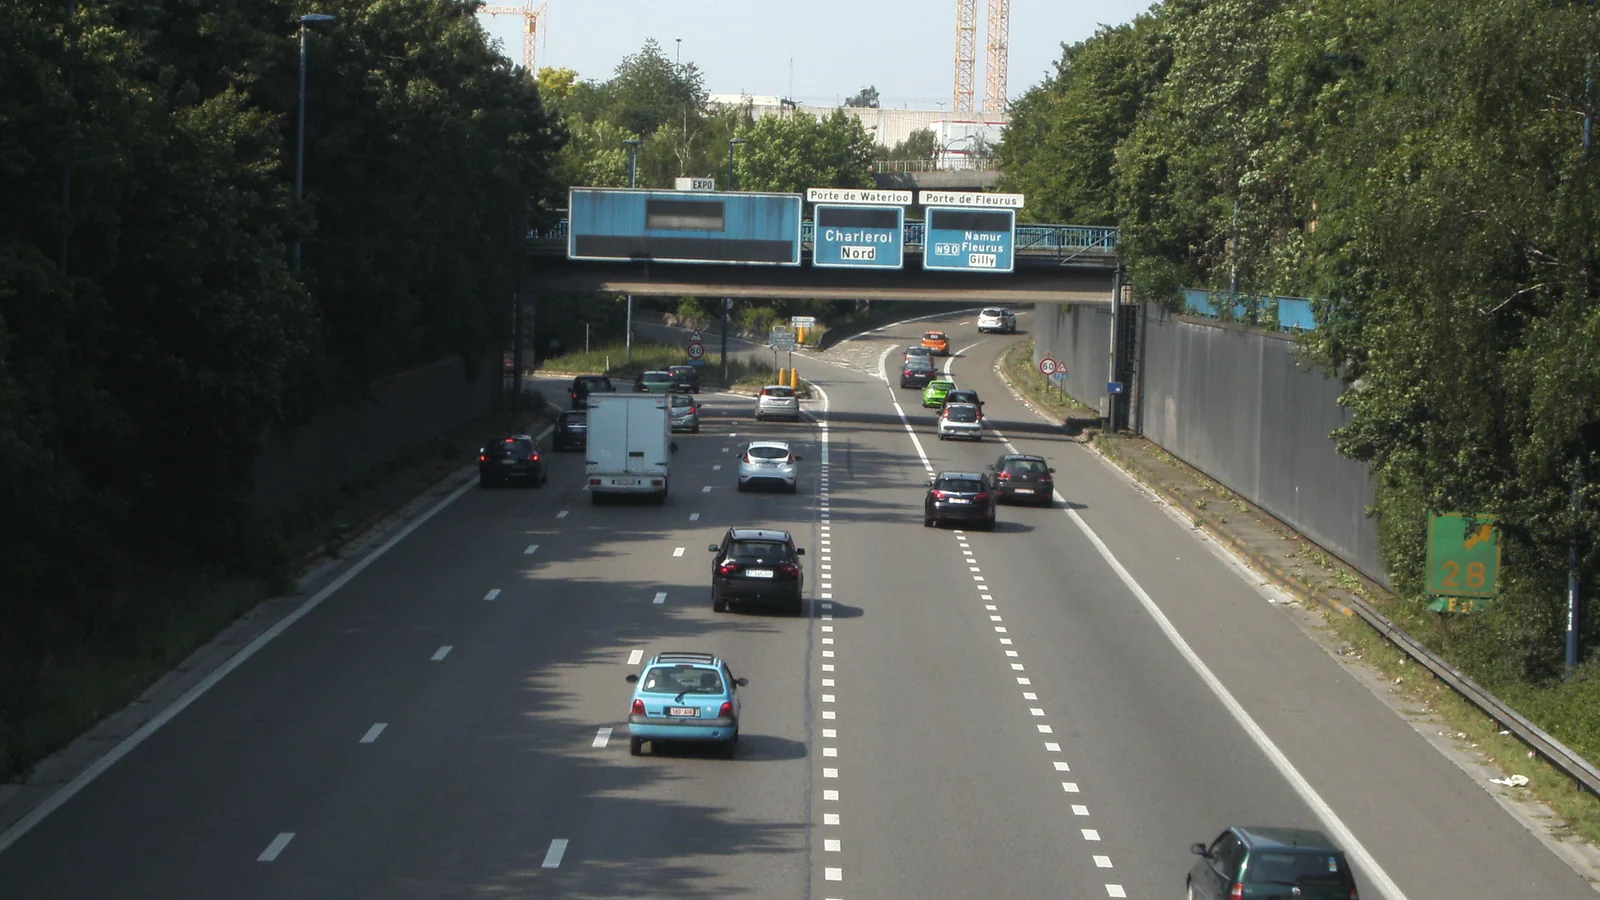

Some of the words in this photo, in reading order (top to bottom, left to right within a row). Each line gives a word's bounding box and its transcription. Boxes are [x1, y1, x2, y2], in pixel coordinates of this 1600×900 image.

[692, 180, 713, 190] EXPO
[810, 190, 840, 200] Porte
[843, 191, 856, 201] de
[860, 192, 909, 202] Waterloo
[926, 193, 955, 203] Porte
[959, 194, 972, 204] de
[975, 195, 1018, 206] Fleurus
[825, 229, 893, 243] Charleroi
[964, 231, 1002, 242] Namur
[841, 246, 875, 259] Nord
[936, 244, 959, 254] N90
[961, 242, 1004, 253] Fleurus
[969, 254, 995, 266] Gilly
[690, 346, 701, 355] 60
[1042, 362, 1054, 371] 60
[1441, 560, 1487, 589] 28
